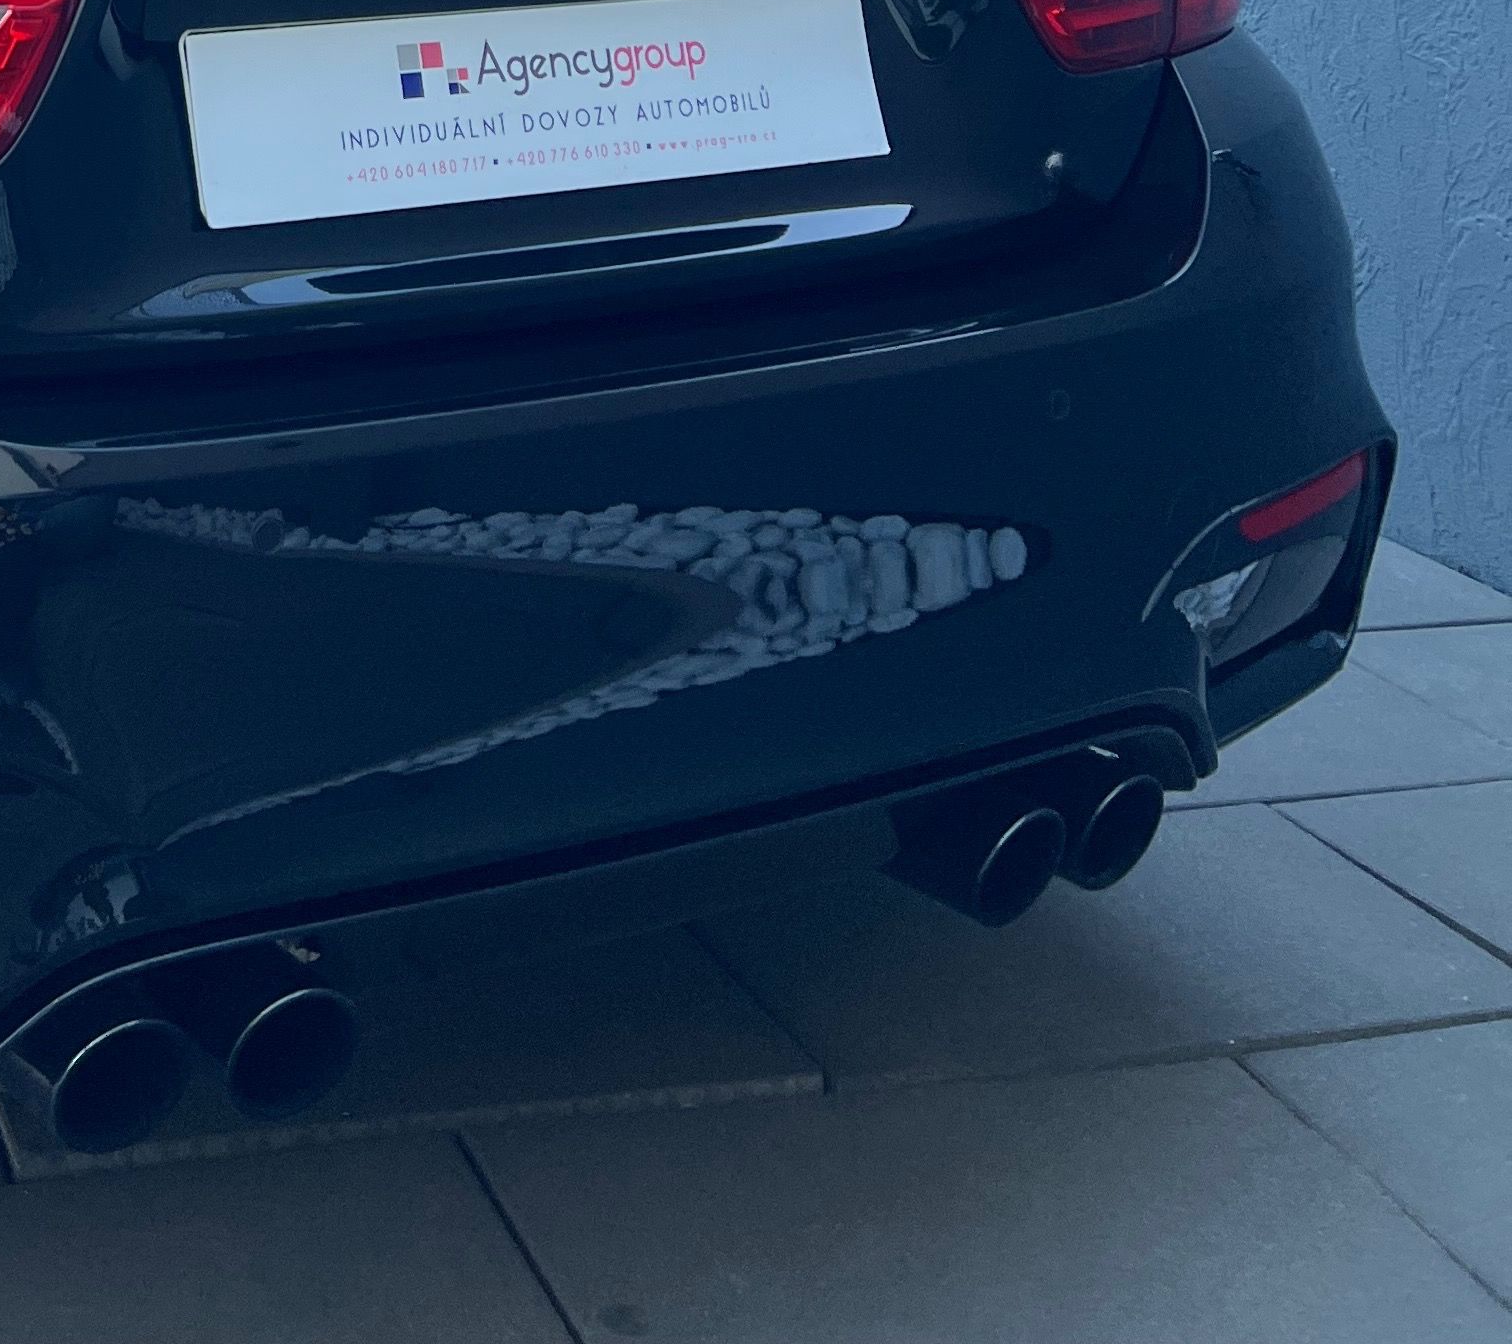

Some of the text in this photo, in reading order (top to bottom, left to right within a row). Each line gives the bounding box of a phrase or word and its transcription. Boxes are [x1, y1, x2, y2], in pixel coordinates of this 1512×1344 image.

[477, 38, 706, 96] Agencygroup
[340, 84, 771, 151] INDIVIDUÁLNÍ DOVOZY AUTOMOBILŮ
[346, 165, 389, 183] +420
[394, 161, 427, 179] 604
[431, 158, 457, 175] 180
[462, 155, 487, 173] 717
[505, 150, 546, 167] +420
[550, 145, 579, 162] 776
[584, 143, 608, 159] 610
[613, 140, 641, 156] 330
